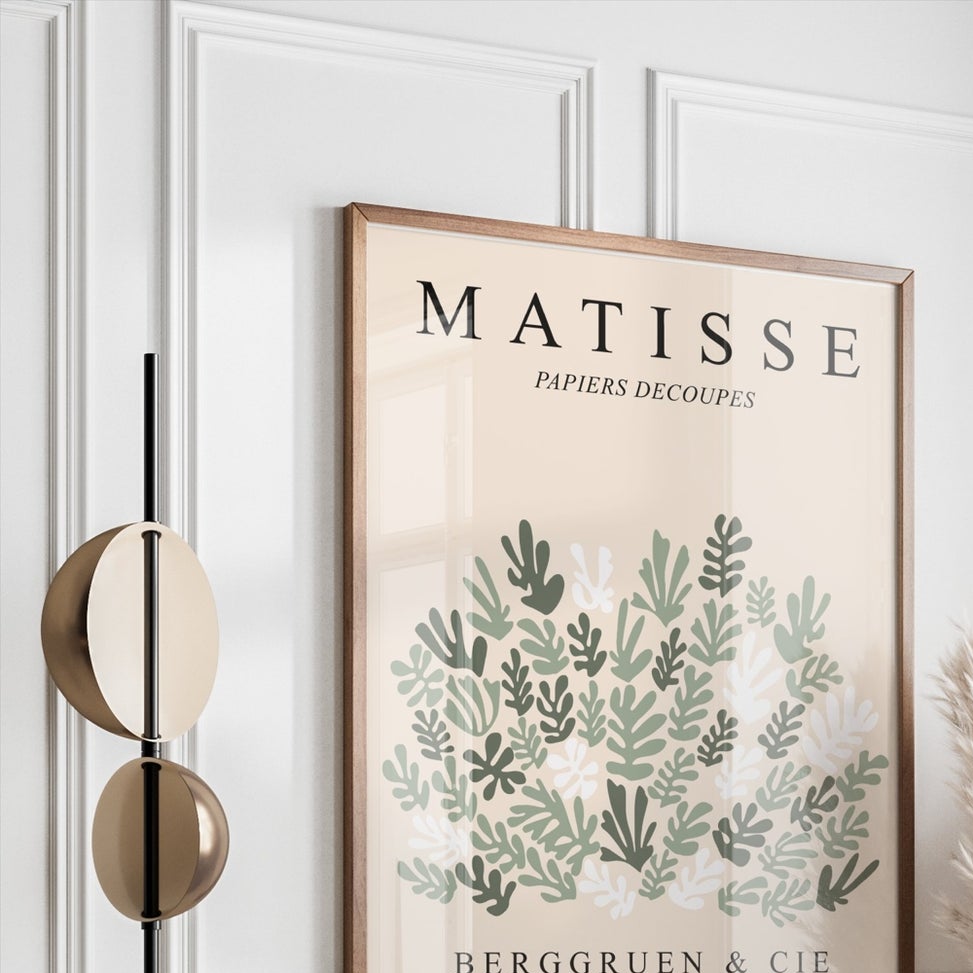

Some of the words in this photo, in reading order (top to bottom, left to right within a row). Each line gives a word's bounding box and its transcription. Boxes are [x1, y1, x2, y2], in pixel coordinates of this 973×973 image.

[415, 279, 861, 379] MATISSE
[534, 370, 630, 397] PAPIERS
[633, 379, 757, 409] DECOUPES
[725, 950, 748, 973] &
[769, 950, 830, 973] CIE
